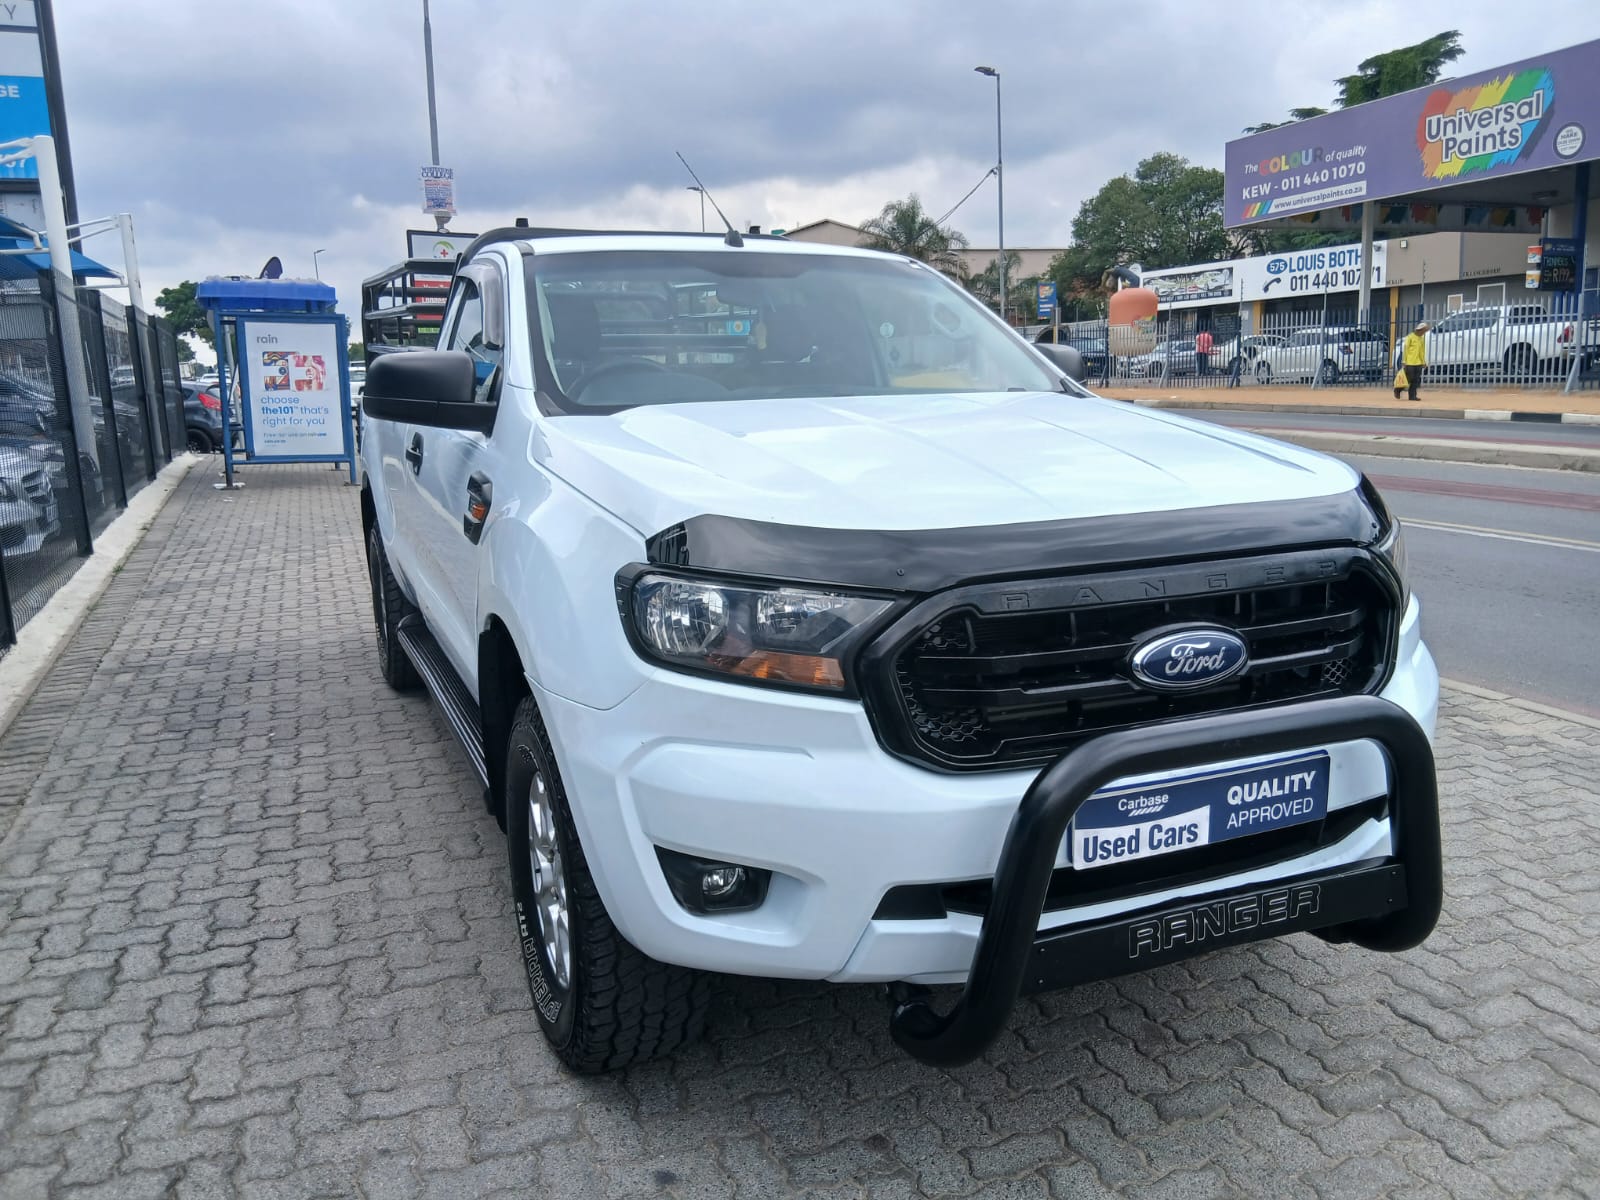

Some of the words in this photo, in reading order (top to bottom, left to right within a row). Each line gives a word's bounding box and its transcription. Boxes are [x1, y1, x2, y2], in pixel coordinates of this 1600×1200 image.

[1426, 90, 1543, 141] Universal
[1443, 125, 1522, 163] Paints
[1244, 162, 1259, 175] The
[1259, 147, 1324, 176] COLOUR
[1325, 152, 1335, 163] of
[1336, 145, 1367, 162] quality
[1242, 184, 1271, 200] KEW
[1281, 175, 1302, 192] 011
[1303, 168, 1329, 186] 440
[1332, 162, 1366, 179] 1070
[1273, 186, 1363, 209] www.universalpaints.co.za
[1269, 261, 1285, 271] 575
[1289, 253, 1325, 273] LOUIS
[1329, 249, 1362, 268] BOTH
[1290, 274, 1309, 291] 011
[1312, 271, 1338, 288] 440
[257, 333, 278, 344] rain
[260, 396, 300, 405] choose
[300, 405, 329, 415] that's
[262, 416, 287, 428] right
[289, 416, 304, 425] for
[306, 417, 325, 429] you
[1000, 560, 1338, 610] RANGER
[1165, 642, 1227, 677] Ford
[1118, 794, 1169, 811] Carbase
[1226, 771, 1317, 806] QUALITY
[1226, 797, 1314, 829] APPROVED
[1083, 828, 1140, 863] Used
[1148, 822, 1199, 854] Cars
[1128, 884, 1321, 959] RANGER
